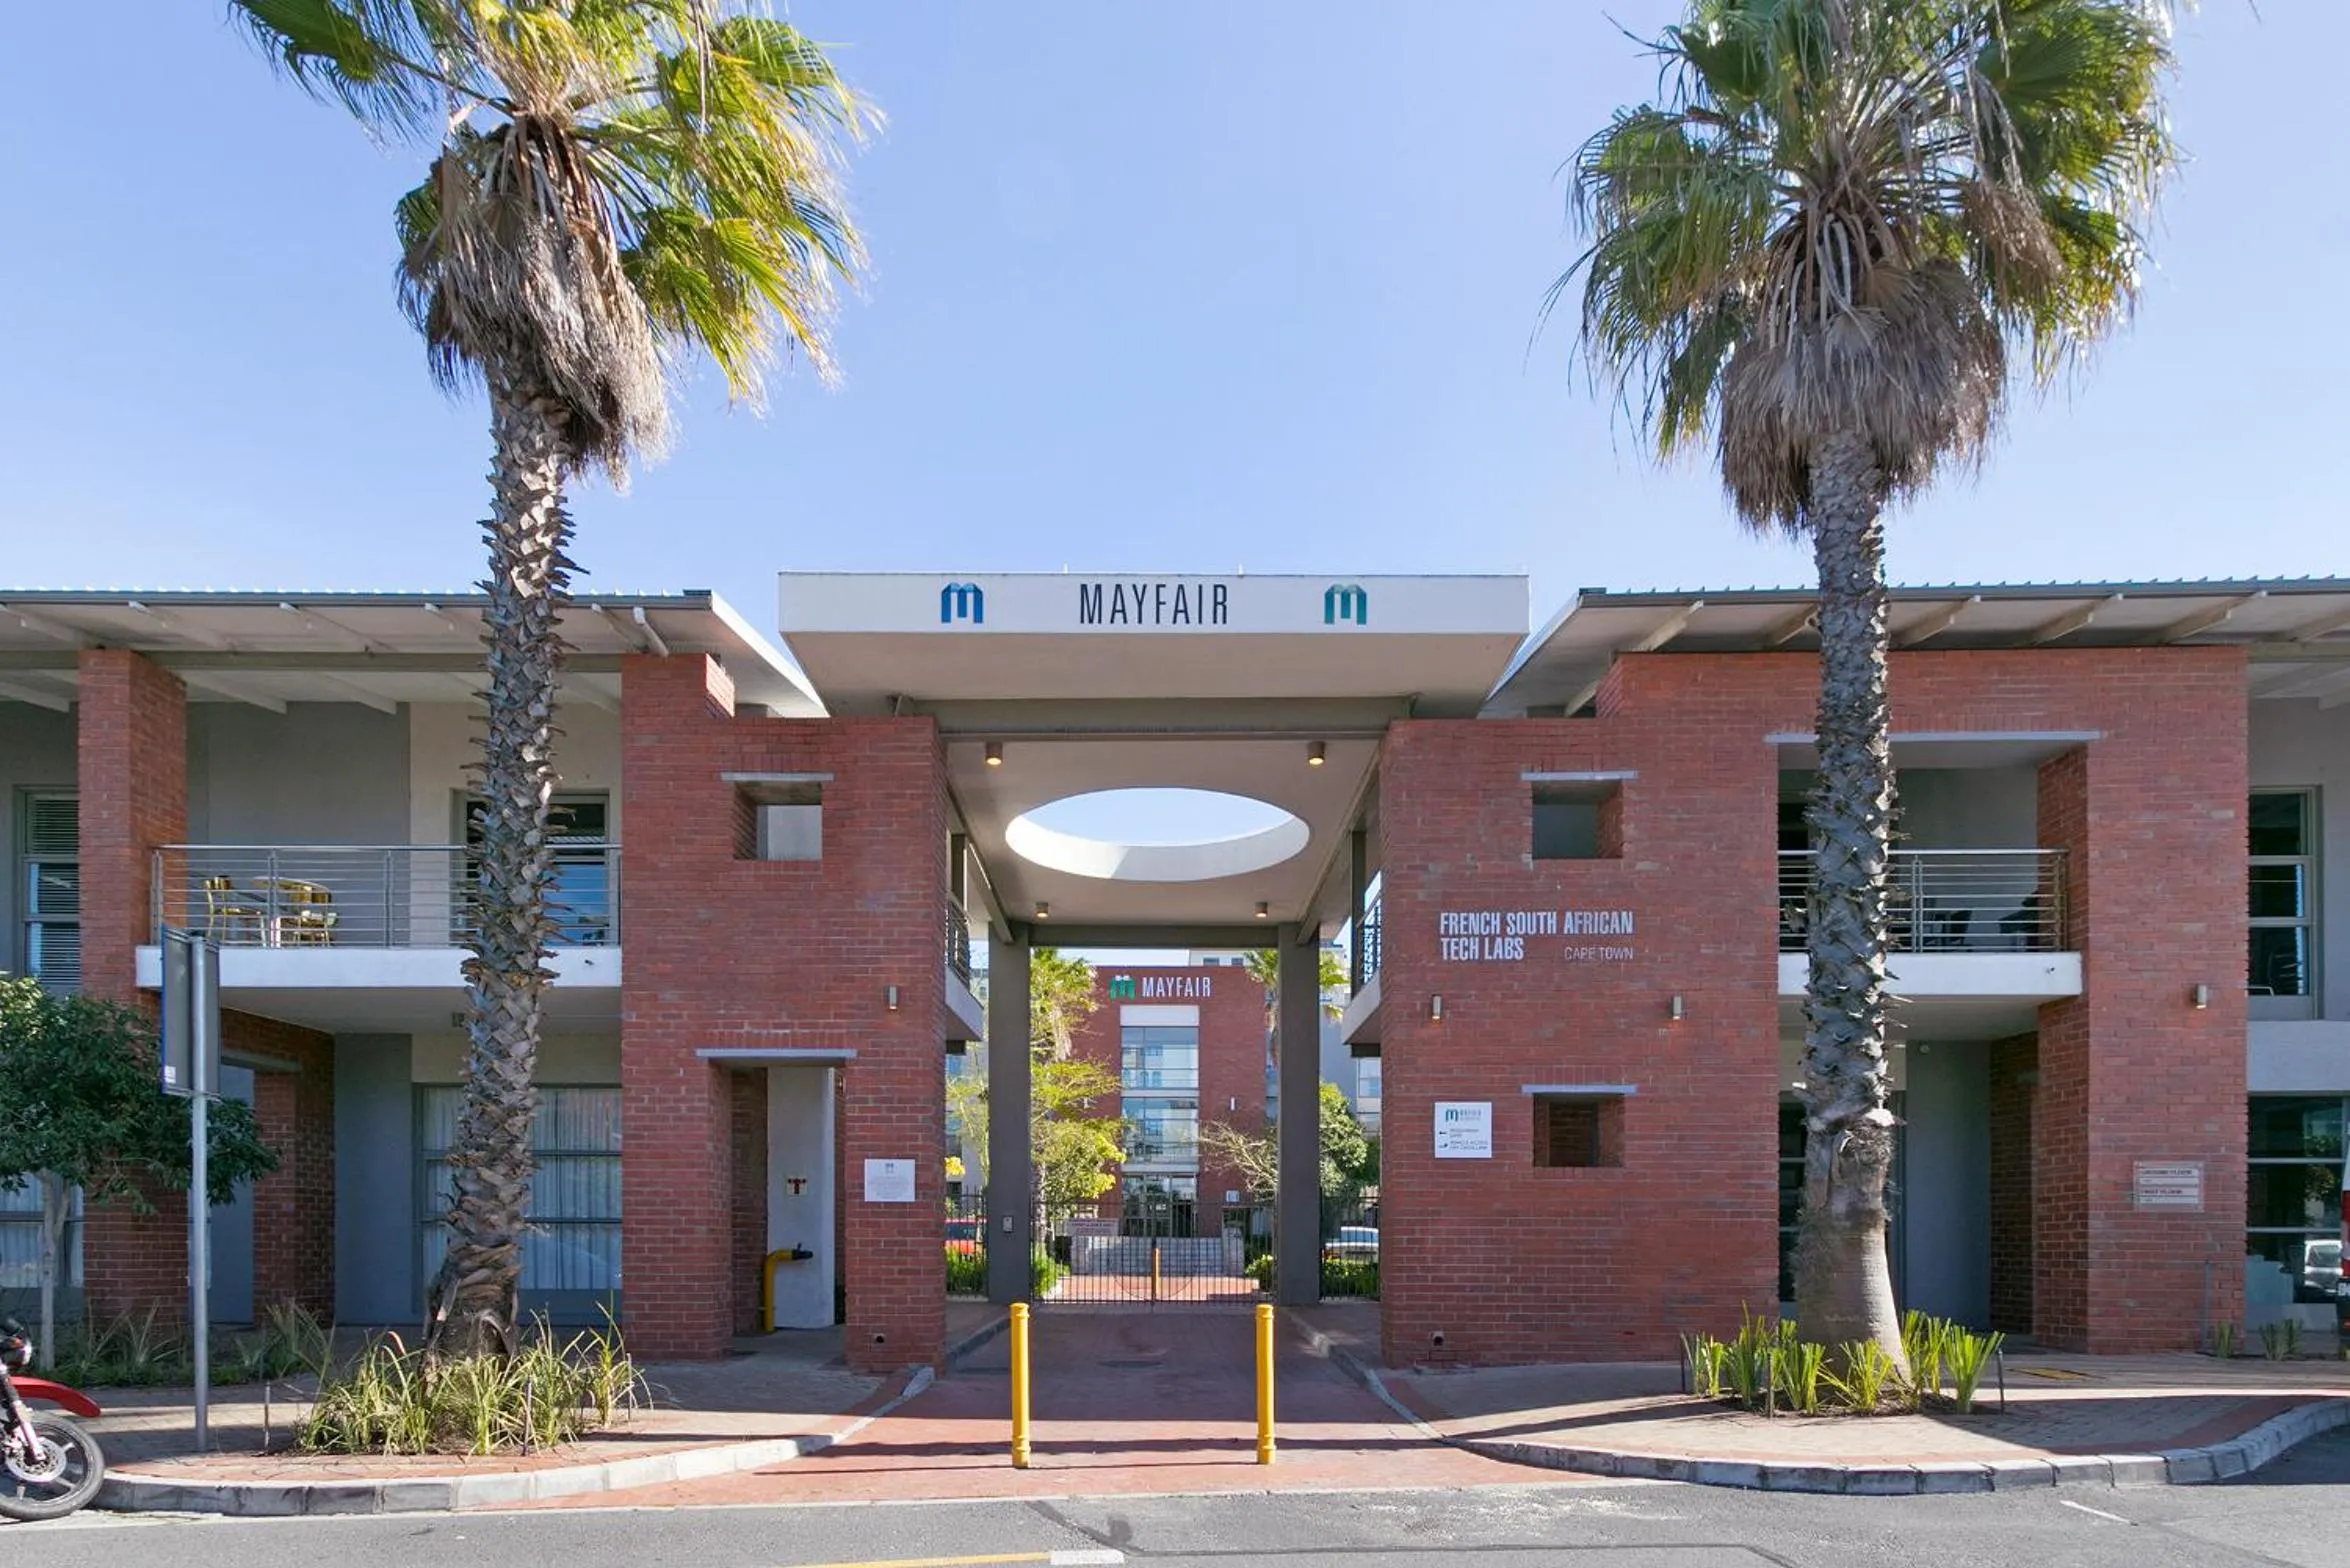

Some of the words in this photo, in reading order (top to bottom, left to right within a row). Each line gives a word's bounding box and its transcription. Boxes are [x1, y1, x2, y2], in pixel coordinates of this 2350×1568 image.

[1080, 583, 1229, 625] MAYFAIR
[1440, 912, 1500, 935] FRENCH
[1506, 911, 1557, 935] SOUTH
[1563, 911, 1634, 935] AFRICAN
[1441, 937, 1479, 960] TECH
[1484, 937, 1524, 960] LABS
[1564, 946, 1595, 961] CAPE
[1598, 946, 1634, 960] TOWN
[1141, 976, 1212, 998] MAYFAIR
